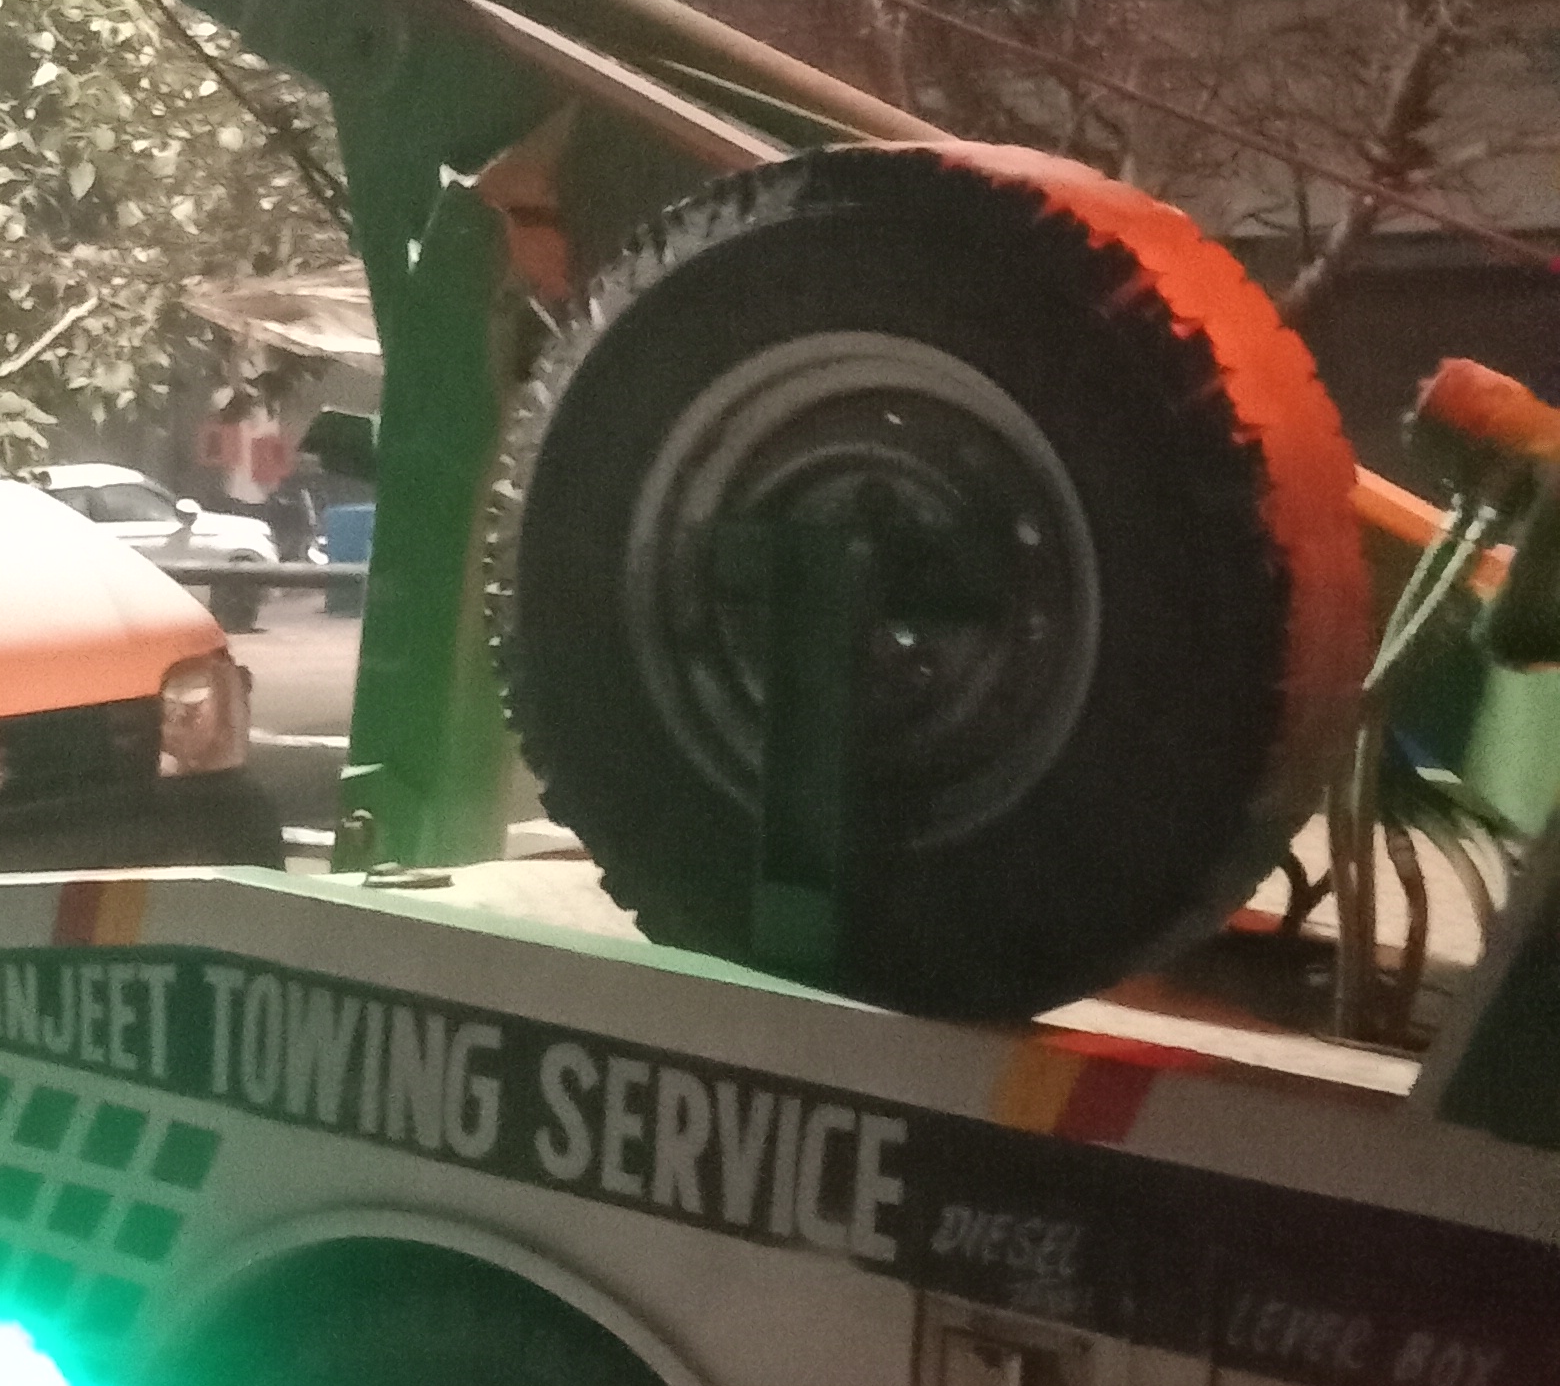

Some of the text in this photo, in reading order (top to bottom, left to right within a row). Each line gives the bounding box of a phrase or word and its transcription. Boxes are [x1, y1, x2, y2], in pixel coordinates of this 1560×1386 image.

[203, 965, 502, 1159] TOWING
[534, 1043, 909, 1262] SERVICE
[931, 1205, 1085, 1277] DIESEL
